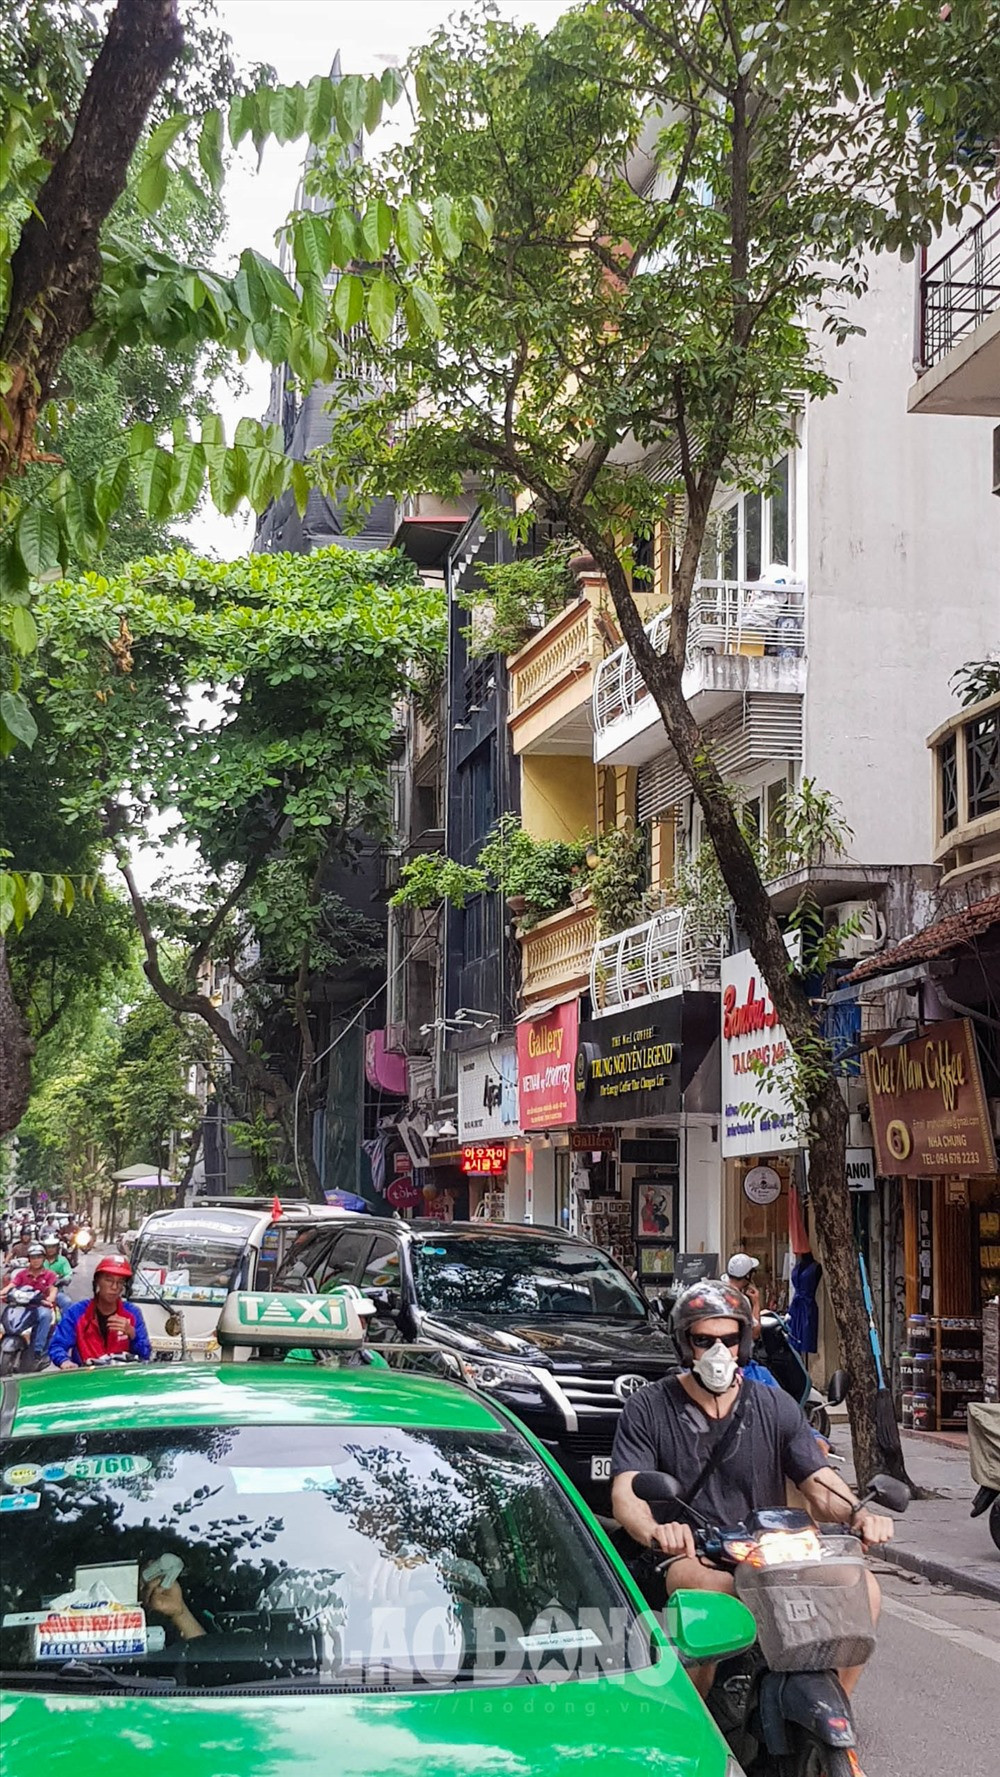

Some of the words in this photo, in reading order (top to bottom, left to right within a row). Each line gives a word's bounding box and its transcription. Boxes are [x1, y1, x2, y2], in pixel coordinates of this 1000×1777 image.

[528, 1025, 564, 1059] Gallery
[591, 1056, 612, 1079] TRUNG
[642, 1043, 673, 1069] LEGEND
[896, 1044, 924, 1098] Nam
[924, 1039, 965, 1112] Coffee
[573, 1133, 614, 1148] Gallery
[928, 1136, 942, 1148] NHA
[943, 1134, 967, 1147] CHUNG
[464, 1148, 506, 1160] 아오자이
[75, 1456, 134, 1477] 5760
